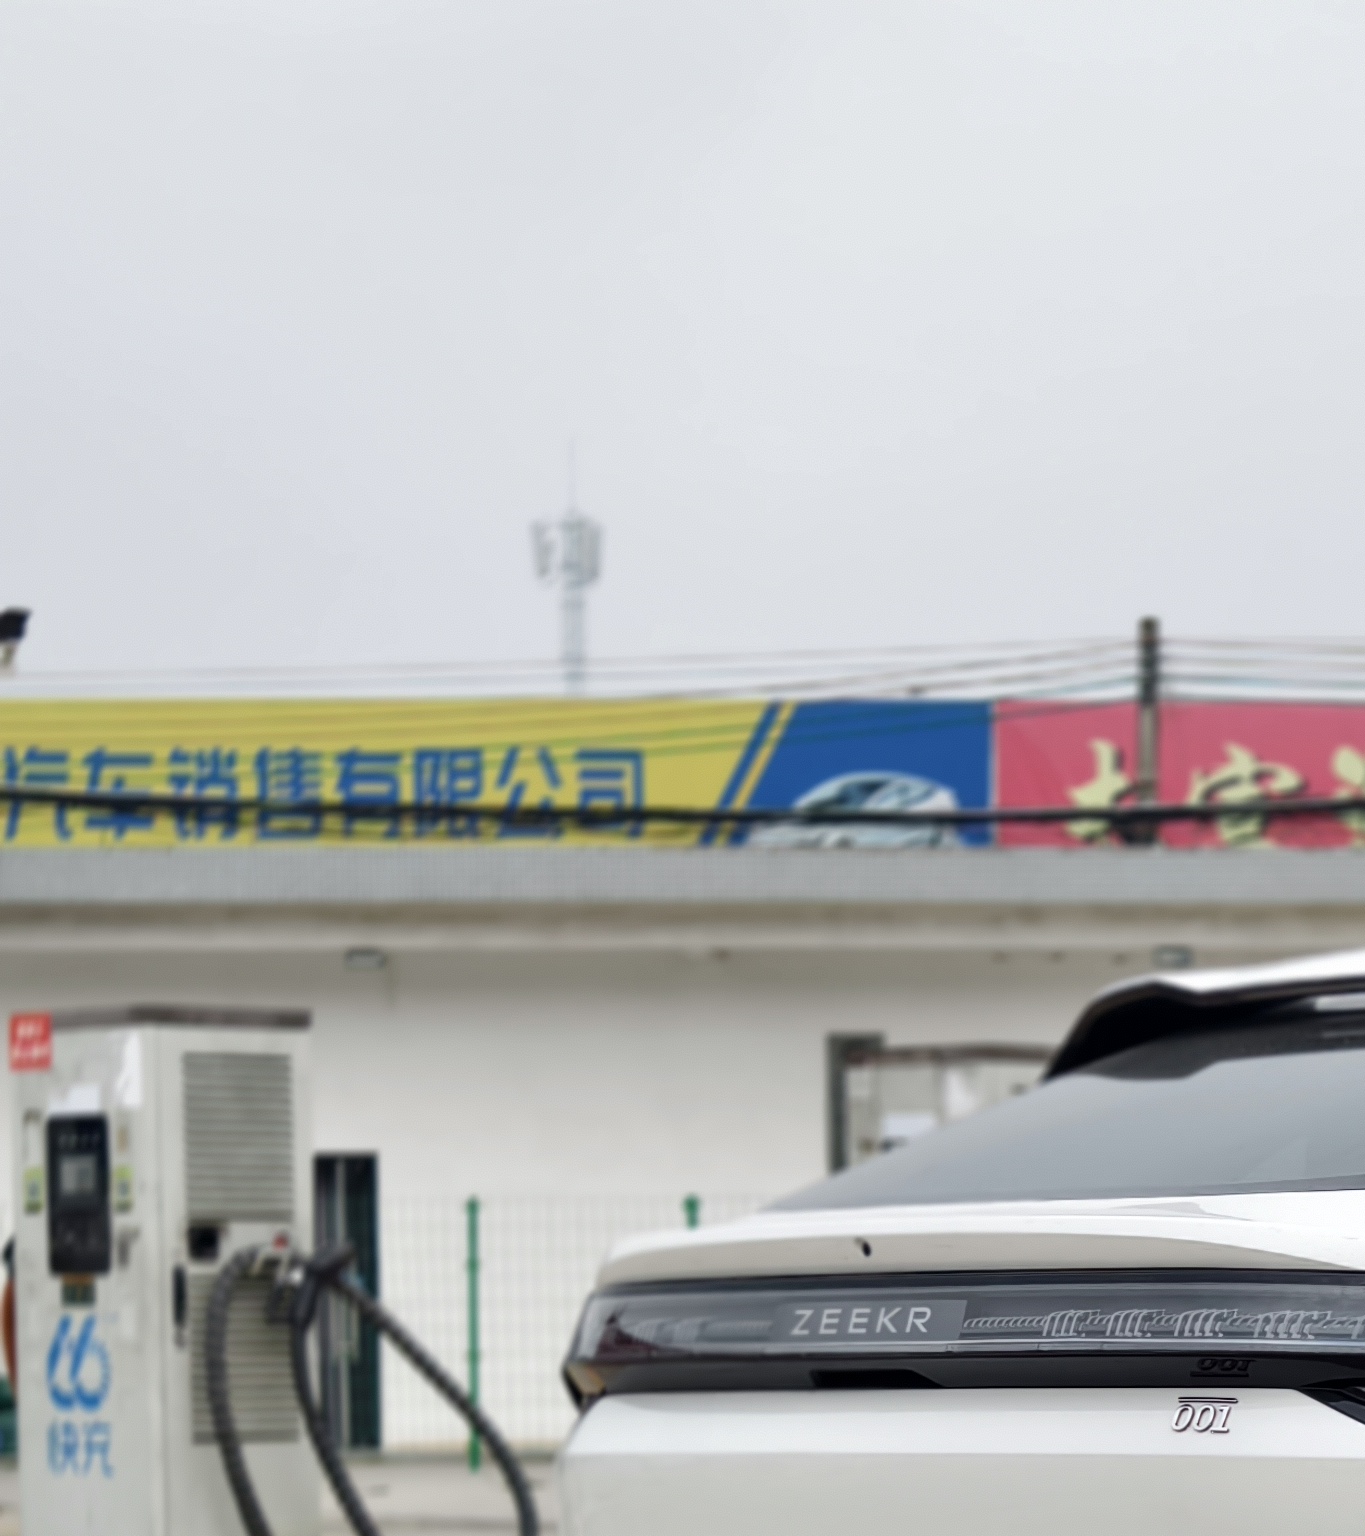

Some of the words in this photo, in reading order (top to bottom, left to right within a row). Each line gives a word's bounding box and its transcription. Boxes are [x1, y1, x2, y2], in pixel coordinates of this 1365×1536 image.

[790, 1307, 932, 1336] ZEEKR
[1171, 1403, 1232, 1434] 001
[47, 1422, 115, 1478] 快充
